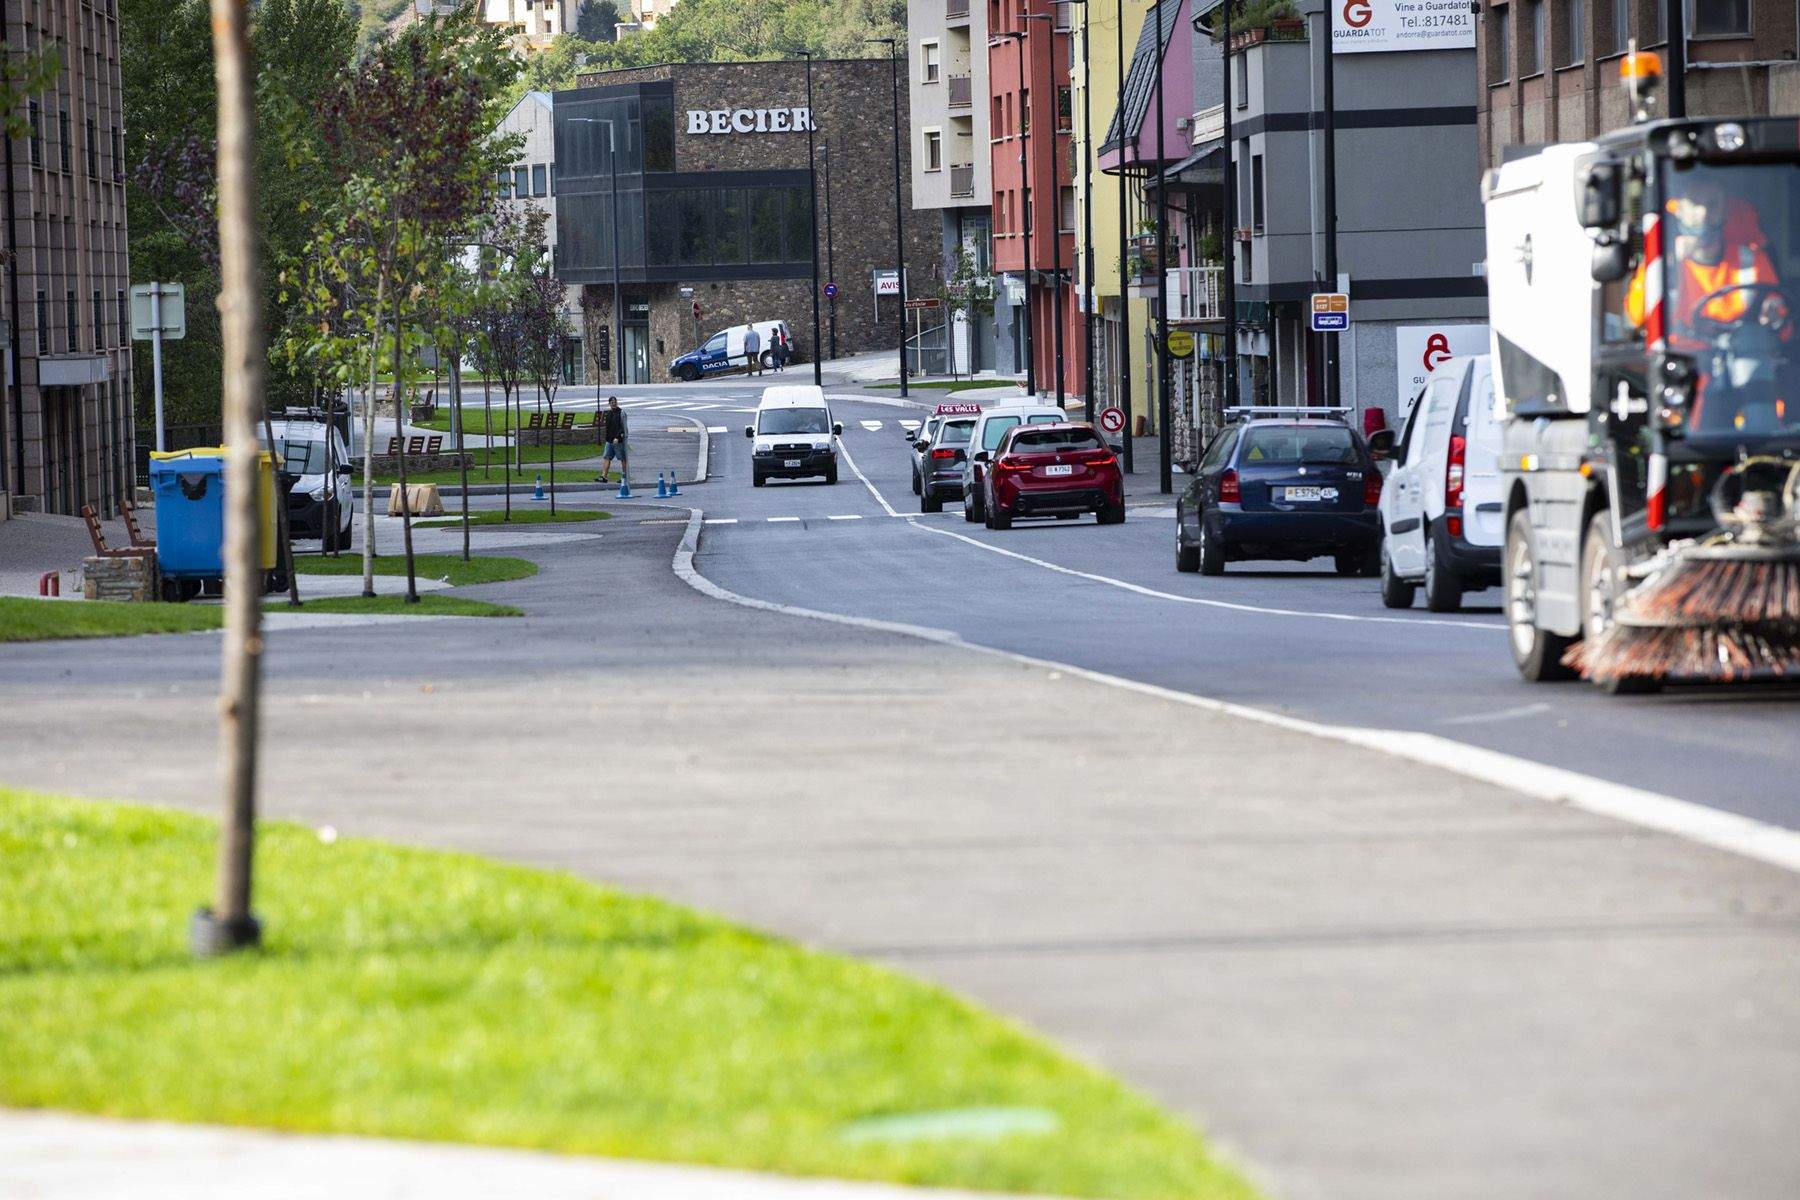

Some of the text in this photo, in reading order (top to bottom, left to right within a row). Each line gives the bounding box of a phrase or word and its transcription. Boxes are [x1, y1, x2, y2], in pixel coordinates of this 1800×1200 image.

[1395, 3, 1416, 12] Vine
[1333, 28, 1387, 38] GUARDATOT
[1395, 29, 1473, 39] andorra@guardatot.com
[686, 107, 817, 134] BECIER
[880, 281, 901, 290] AVIS
[702, 360, 728, 370] DACIA
[955, 404, 978, 412] VALLS
